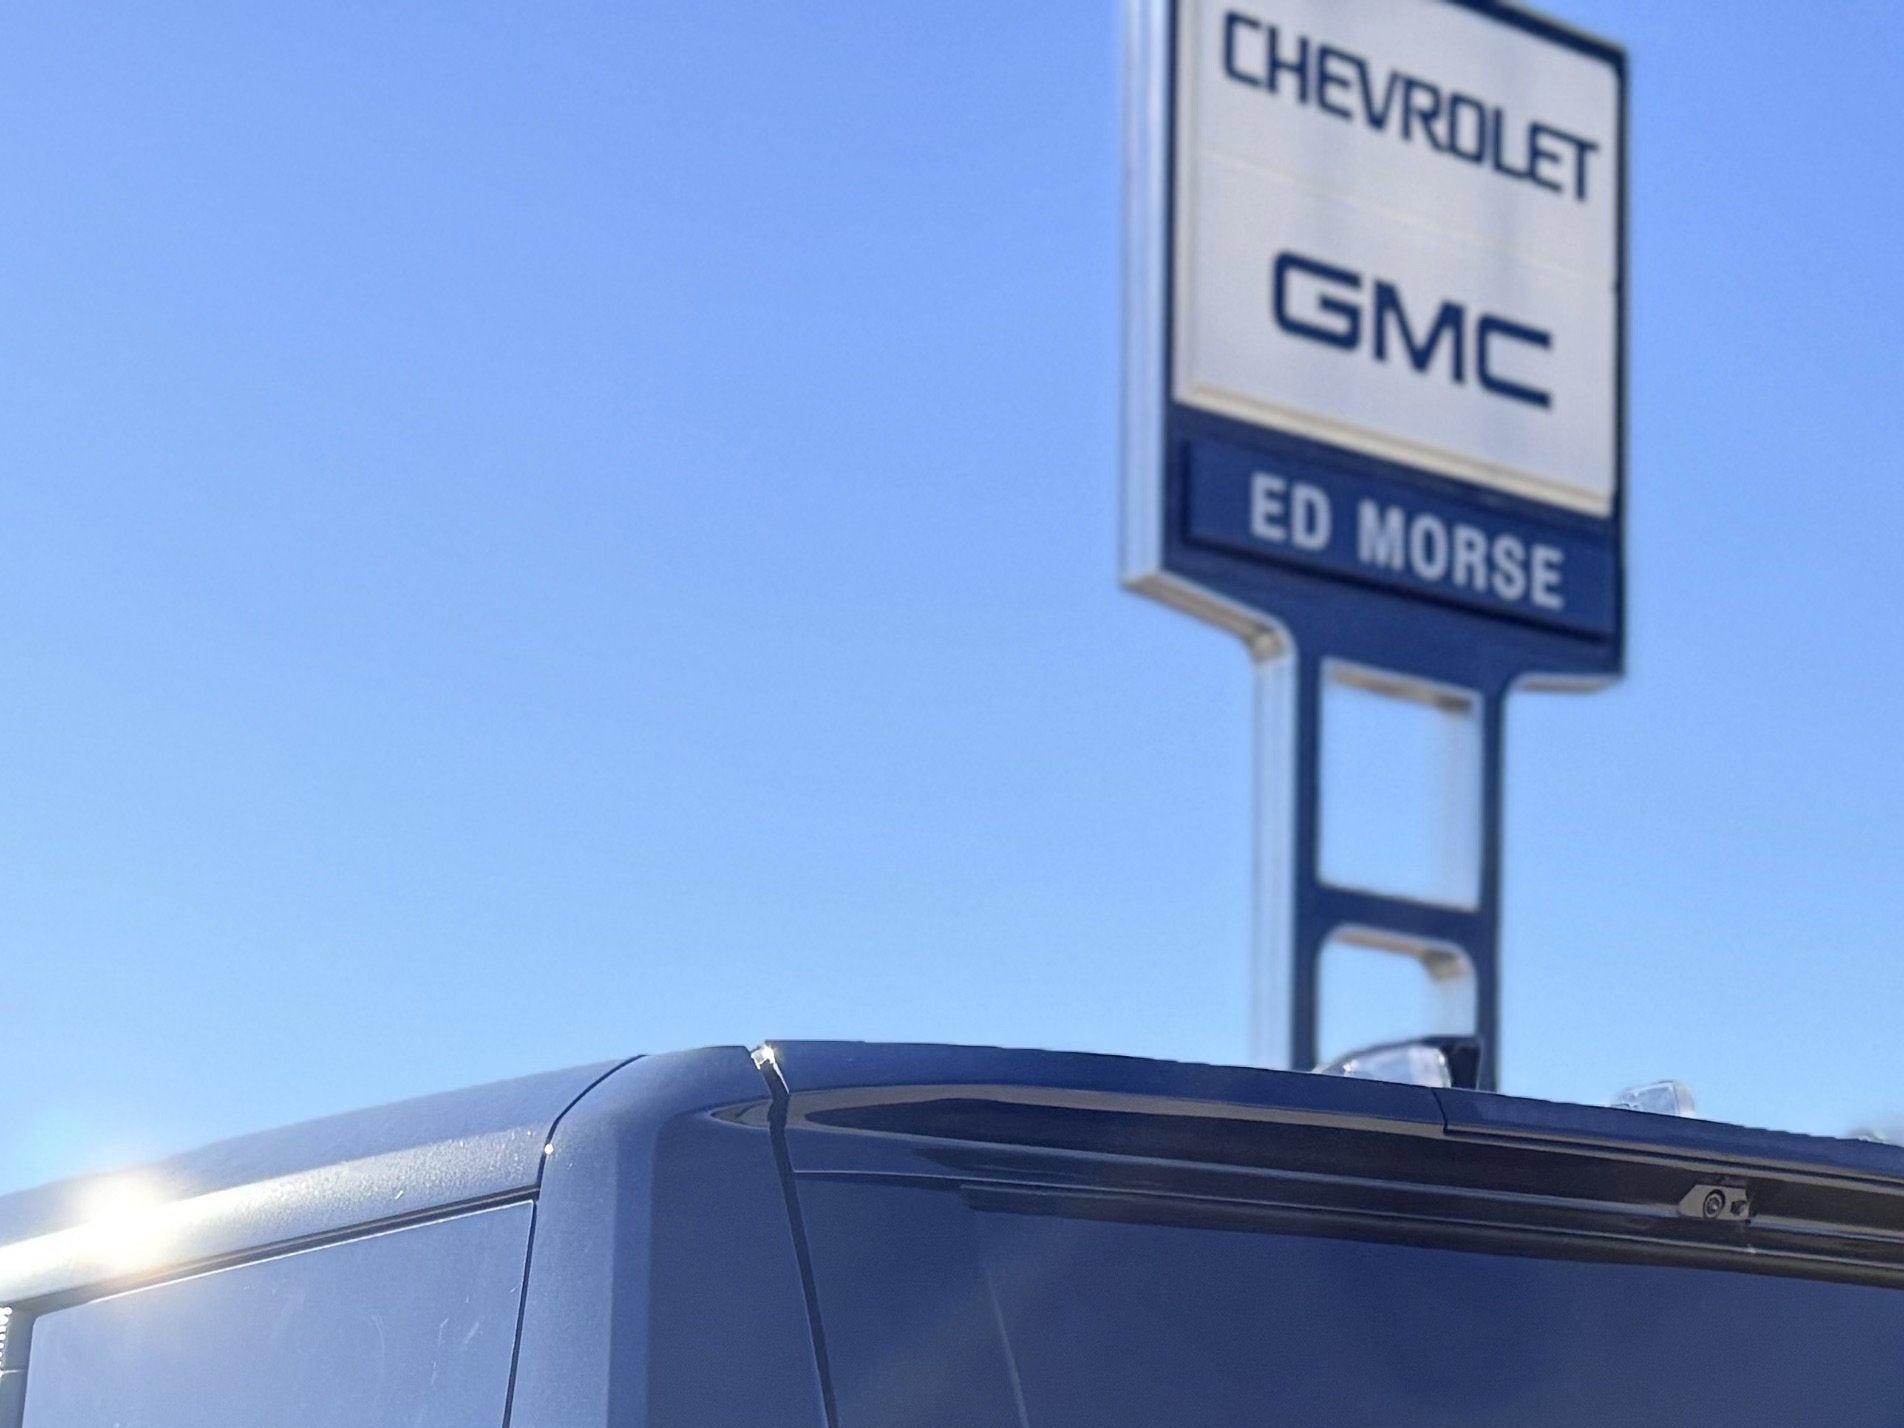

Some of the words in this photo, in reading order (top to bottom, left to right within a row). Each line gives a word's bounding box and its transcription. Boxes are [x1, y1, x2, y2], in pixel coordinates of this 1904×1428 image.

[1224, 12, 1598, 201] CHEVROLET
[1271, 252, 1552, 409] GMC
[1250, 474, 1331, 551] ED
[1359, 500, 1564, 610] MORSE
